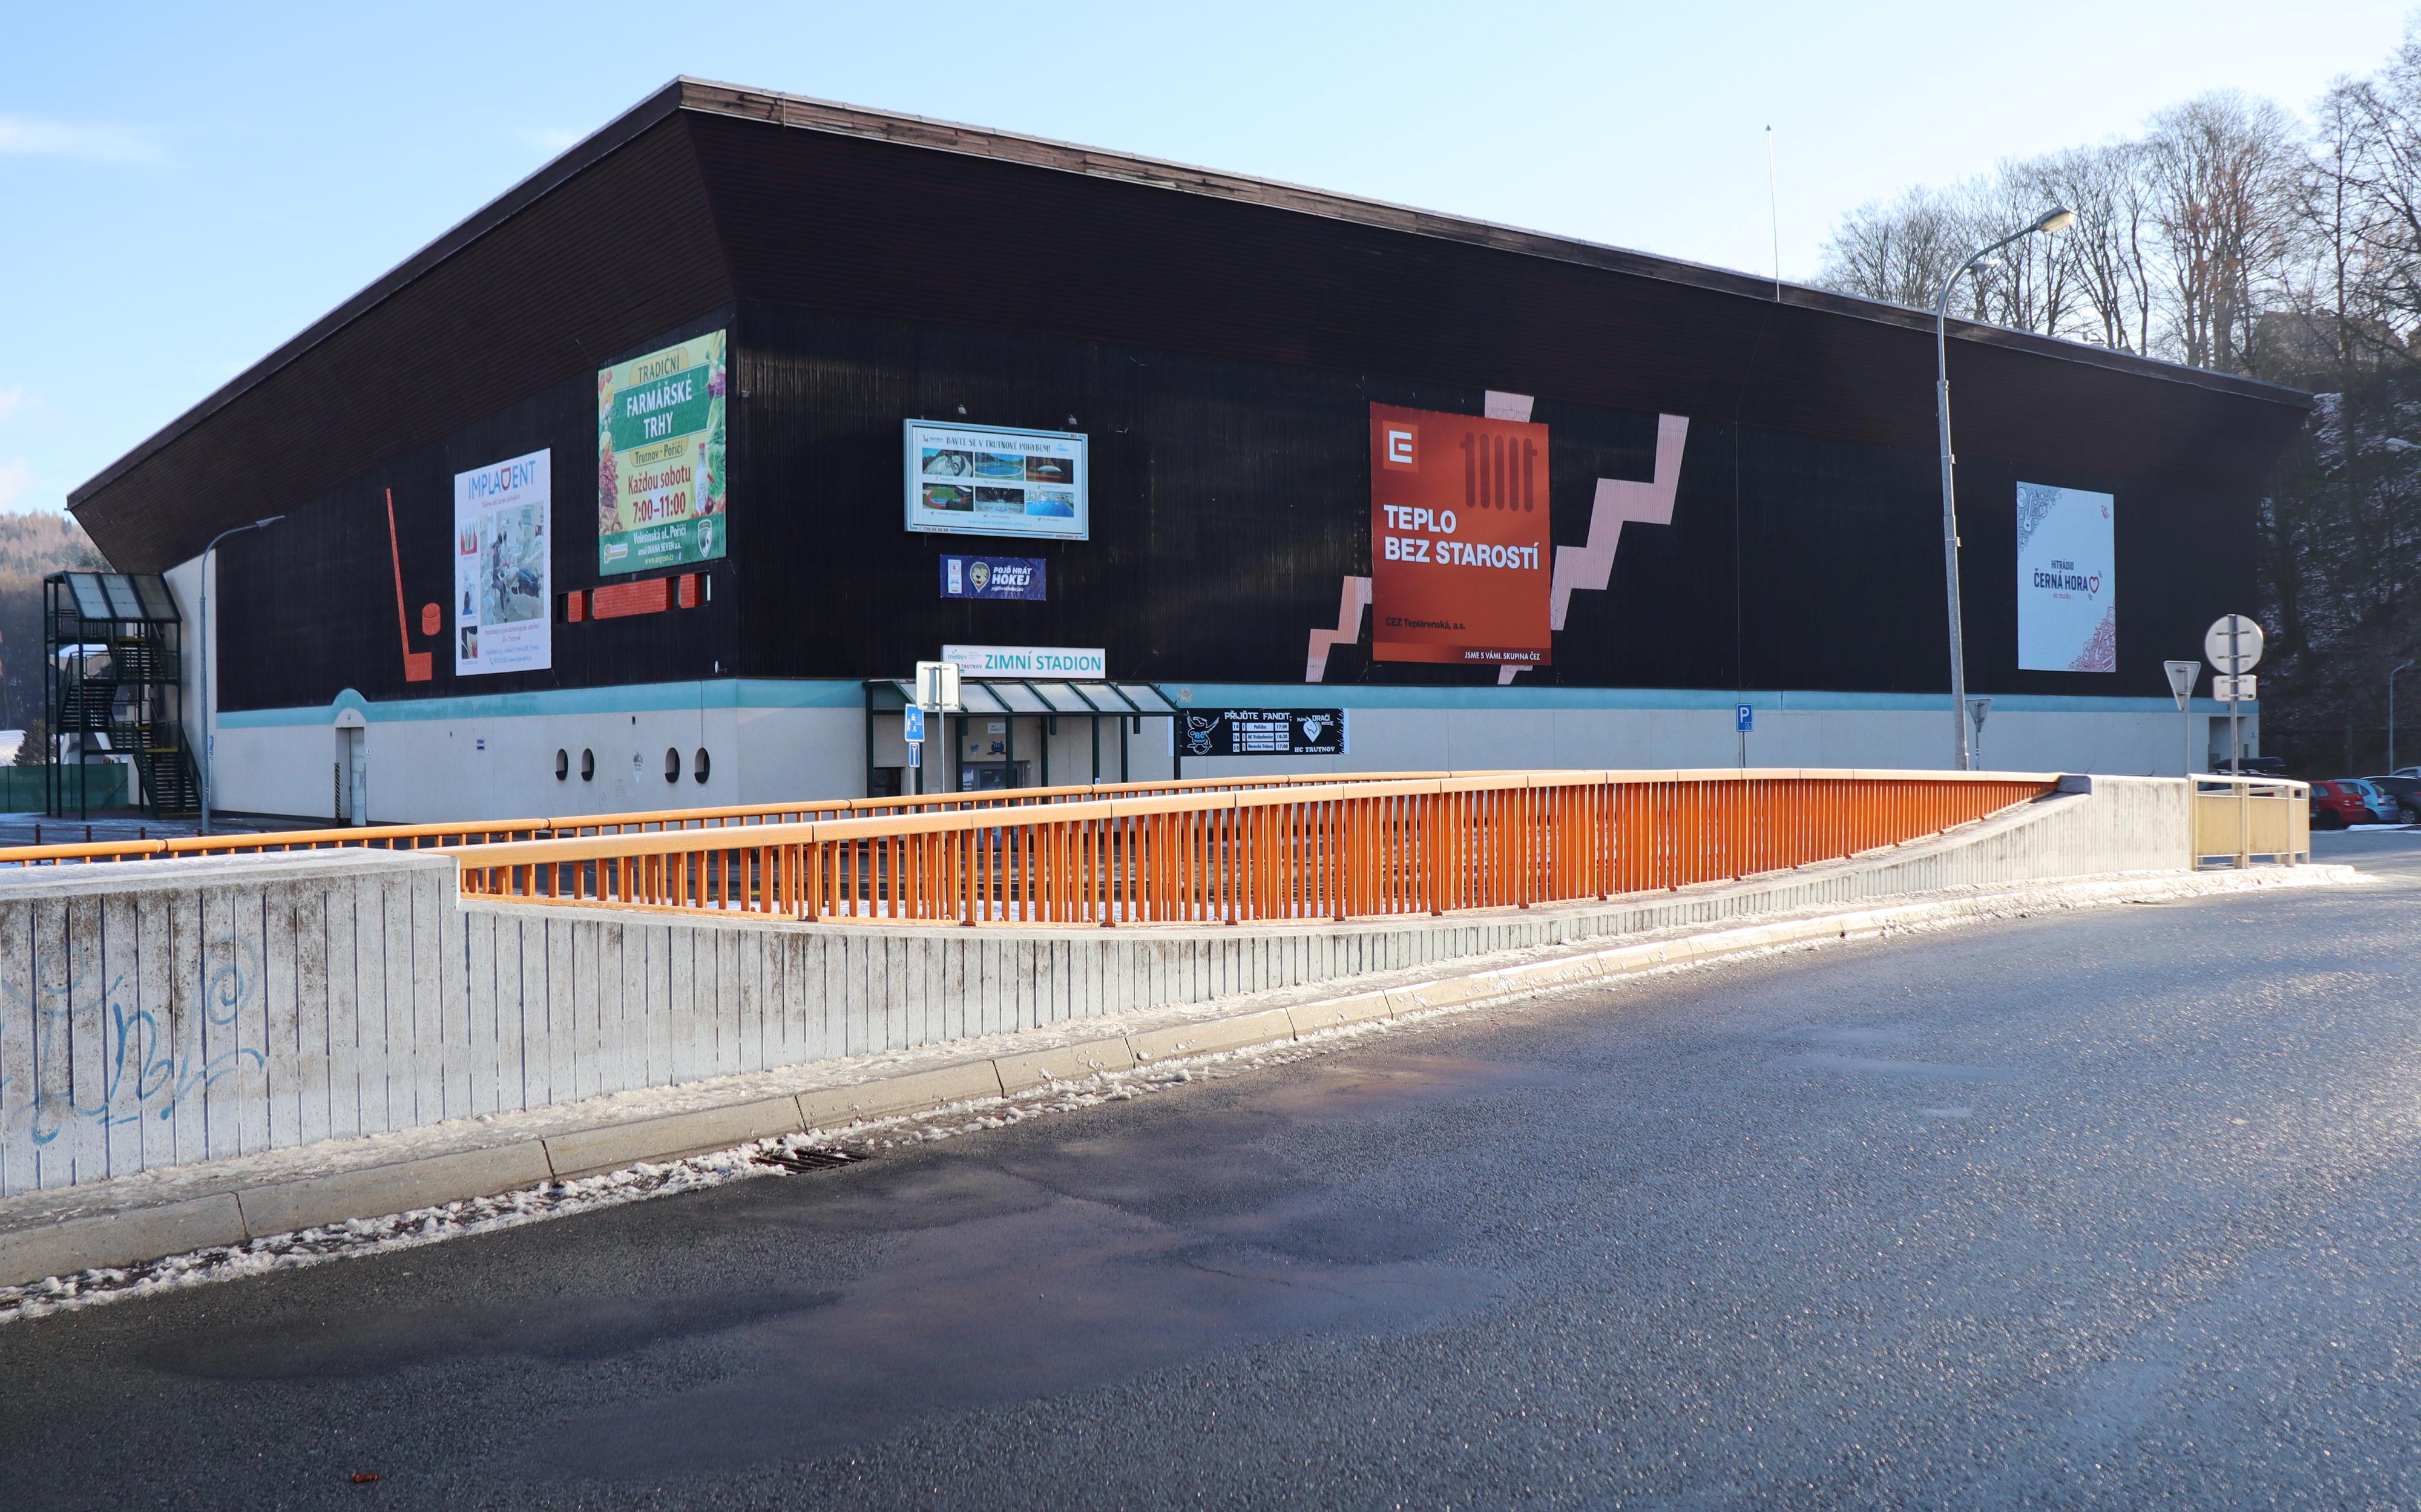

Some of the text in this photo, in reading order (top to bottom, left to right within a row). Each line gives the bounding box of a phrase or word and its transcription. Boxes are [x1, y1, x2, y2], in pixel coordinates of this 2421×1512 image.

[639, 350, 679, 382] TRADIČNÍ
[627, 373, 692, 418] FARMÁŘSKÉ
[643, 412, 673, 439] TRHY
[636, 450, 659, 464] Trutnov
[664, 441, 683, 458] Poříčí
[946, 436, 966, 445] BAVTE
[1019, 442, 1051, 452] POHYBEM!
[468, 460, 536, 500] IMPLADENT
[628, 465, 691, 495] Každou sobotu
[1384, 504, 1457, 534] TEPLO
[1385, 536, 1539, 570] BEZ STAROSTÍ
[991, 574, 1030, 585] HOKEJ
[993, 565, 1033, 574] POJĎ HRÁT
[2034, 568, 2088, 591] ČERNÁ HORA
[985, 651, 1033, 669] ZIMNÍ
[1036, 655, 1101, 671] STADION
[1485, 650, 1502, 659] VÁMI.
[1529, 651, 1540, 660] ČEZ
[1224, 710, 1292, 721] PŘIJĎTE FANDIT:
[1740, 707, 1749, 723] P
